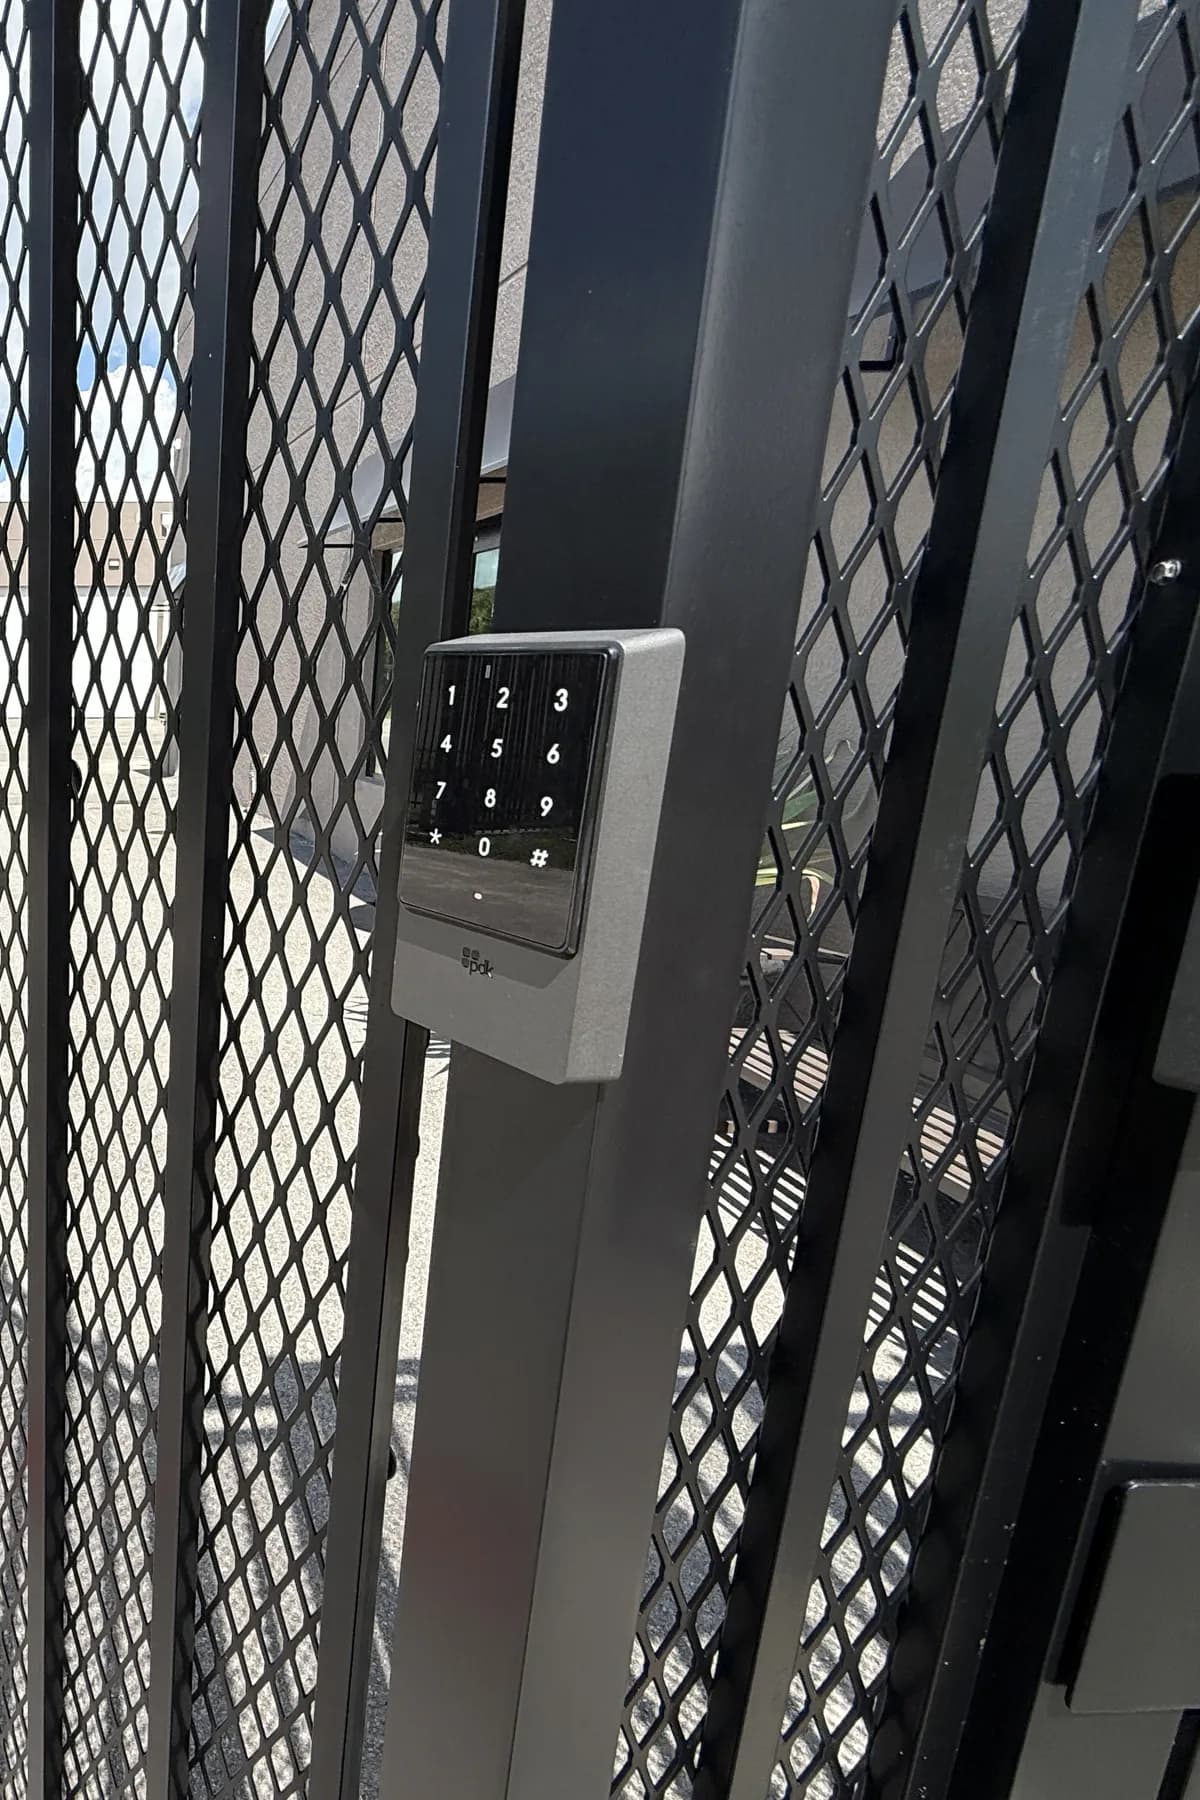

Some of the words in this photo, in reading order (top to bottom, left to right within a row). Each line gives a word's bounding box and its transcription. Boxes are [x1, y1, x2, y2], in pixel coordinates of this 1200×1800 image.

[448, 684, 456, 706] 1
[496, 686, 510, 709] 2
[553, 687, 569, 712] 3
[440, 734, 453, 753] 4
[490, 738, 504, 758] 5
[546, 743, 560, 765] 6
[435, 781, 447, 800] 7
[484, 788, 497, 808] 8
[540, 796, 554, 817] 9
[478, 836, 491, 857] 0
[529, 848, 549, 868] #
